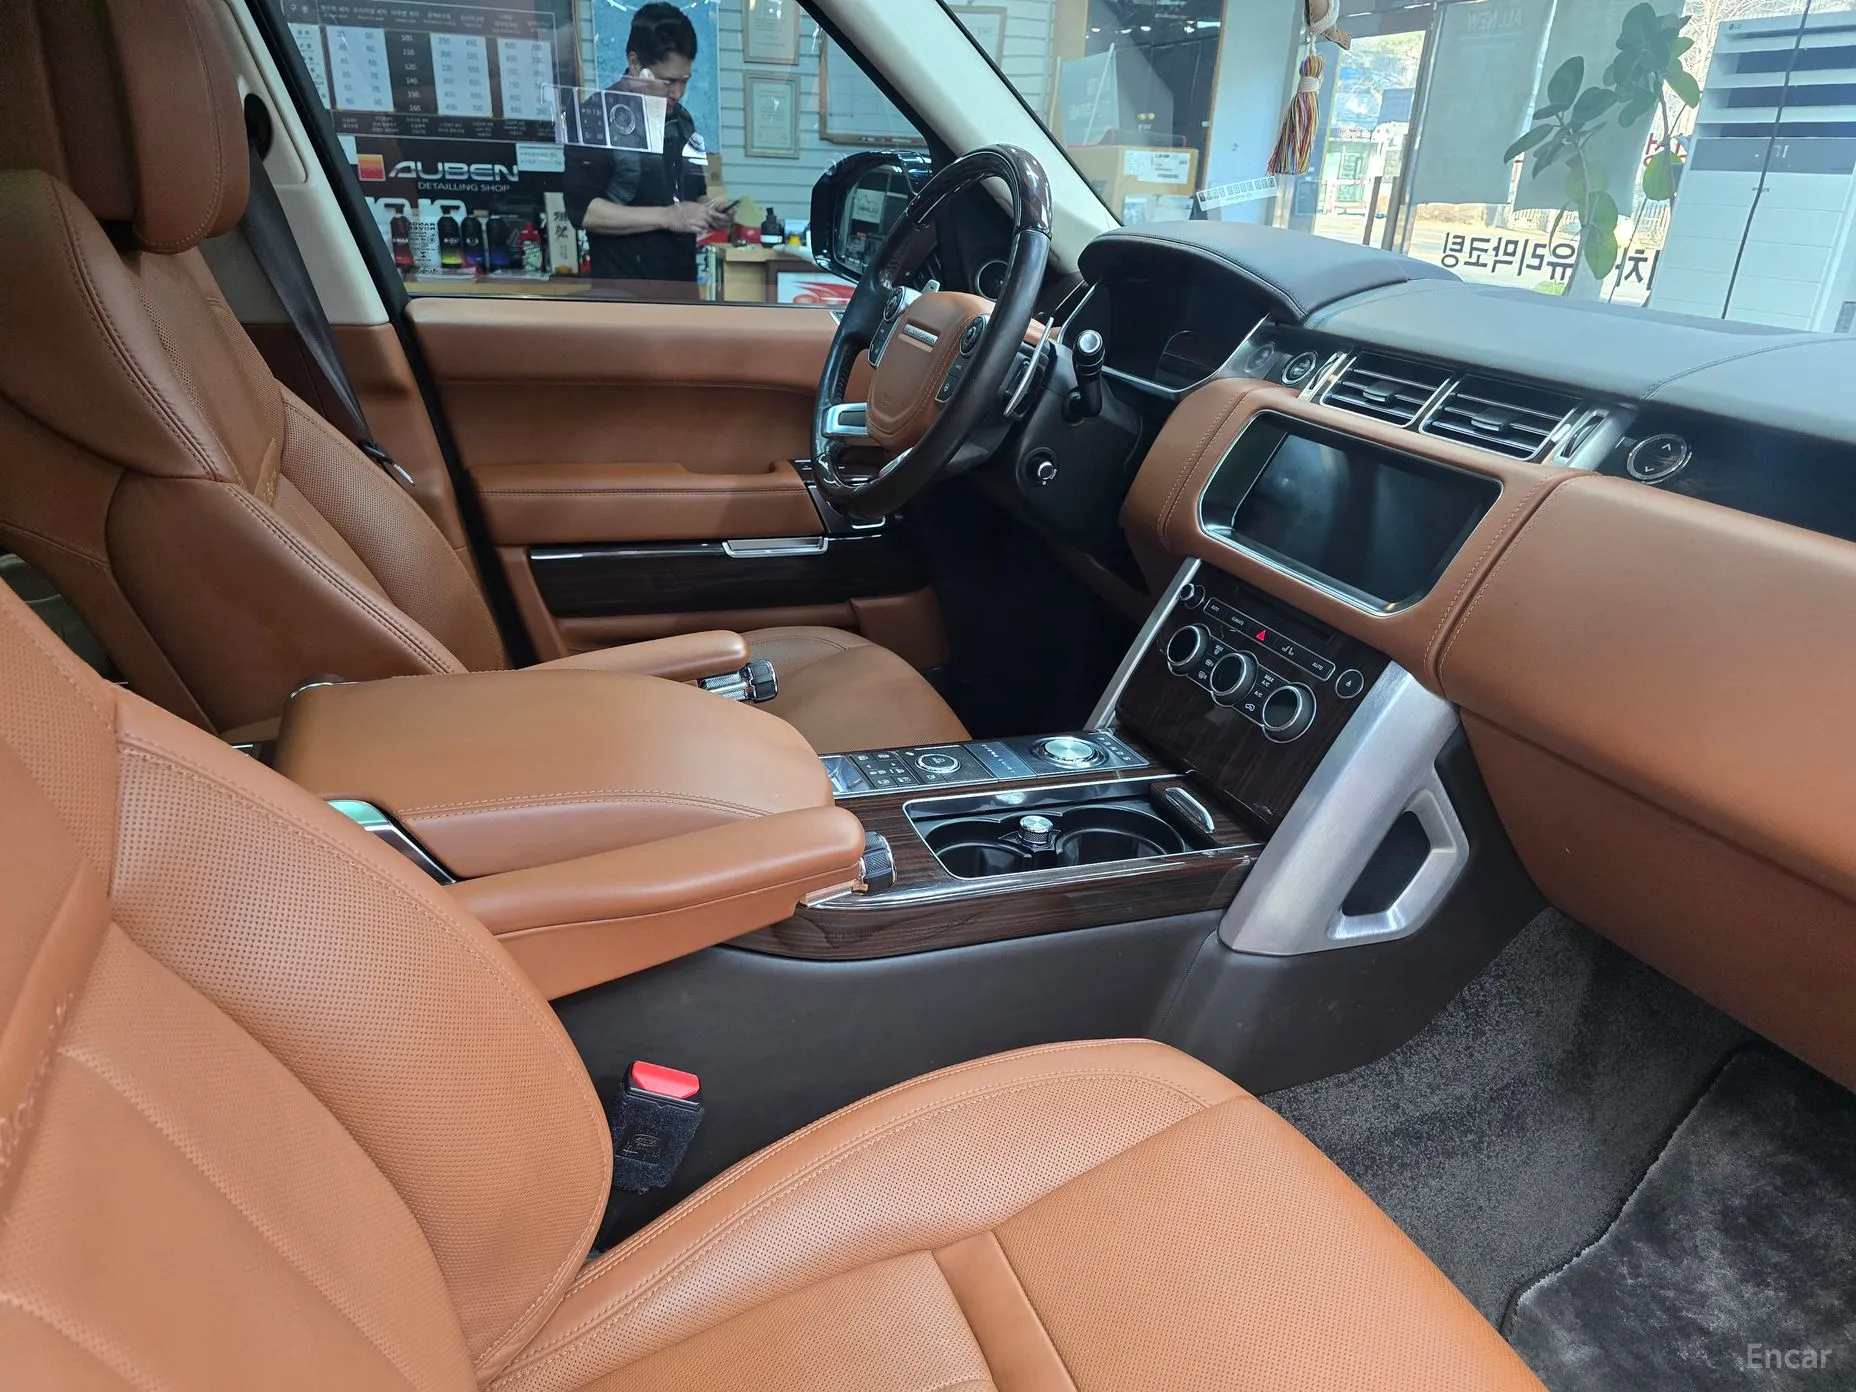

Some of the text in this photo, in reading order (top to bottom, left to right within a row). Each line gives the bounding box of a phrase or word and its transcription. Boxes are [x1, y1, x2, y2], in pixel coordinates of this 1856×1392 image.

[388, 160, 519, 182] AUBEN
[480, 183, 510, 193] SHOP
[1312, 662, 1324, 671] AUTO
[1264, 674, 1275, 683] MAX
[1261, 680, 1271, 688] A/C
[1254, 690, 1263, 698] A/C
